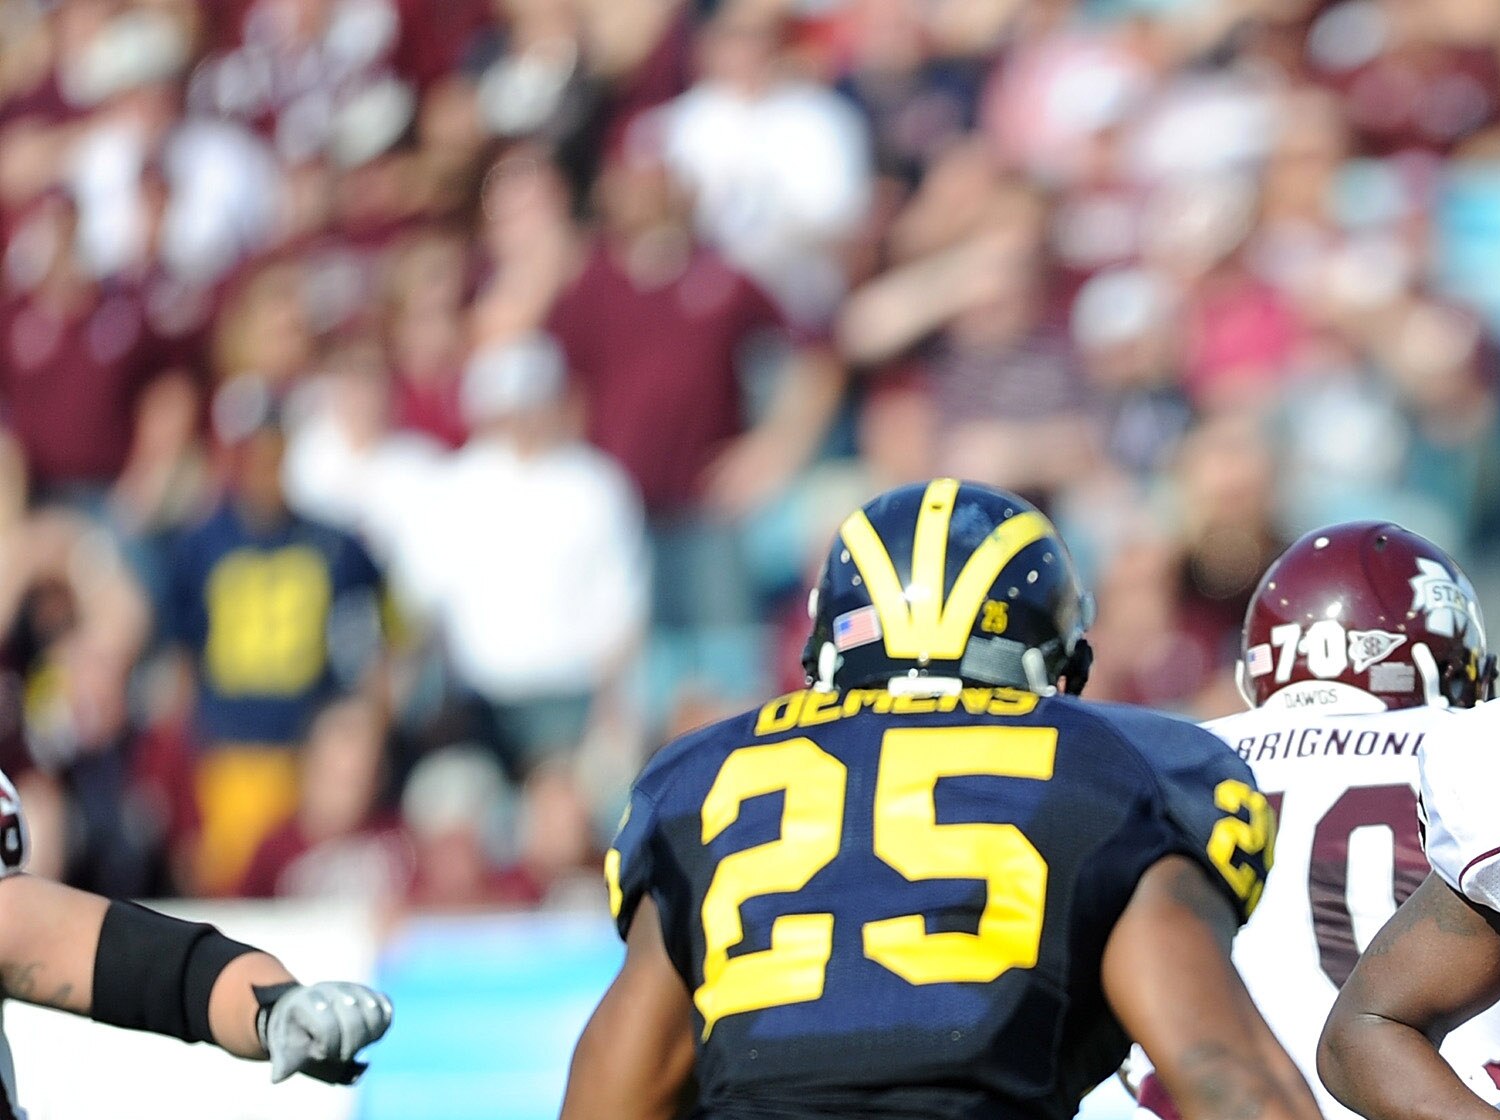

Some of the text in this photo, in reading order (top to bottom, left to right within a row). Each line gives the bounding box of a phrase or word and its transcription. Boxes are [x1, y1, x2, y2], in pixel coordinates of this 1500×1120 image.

[981, 599, 1009, 634] 25
[1271, 619, 1348, 684] 70
[694, 725, 1059, 1022] 25
